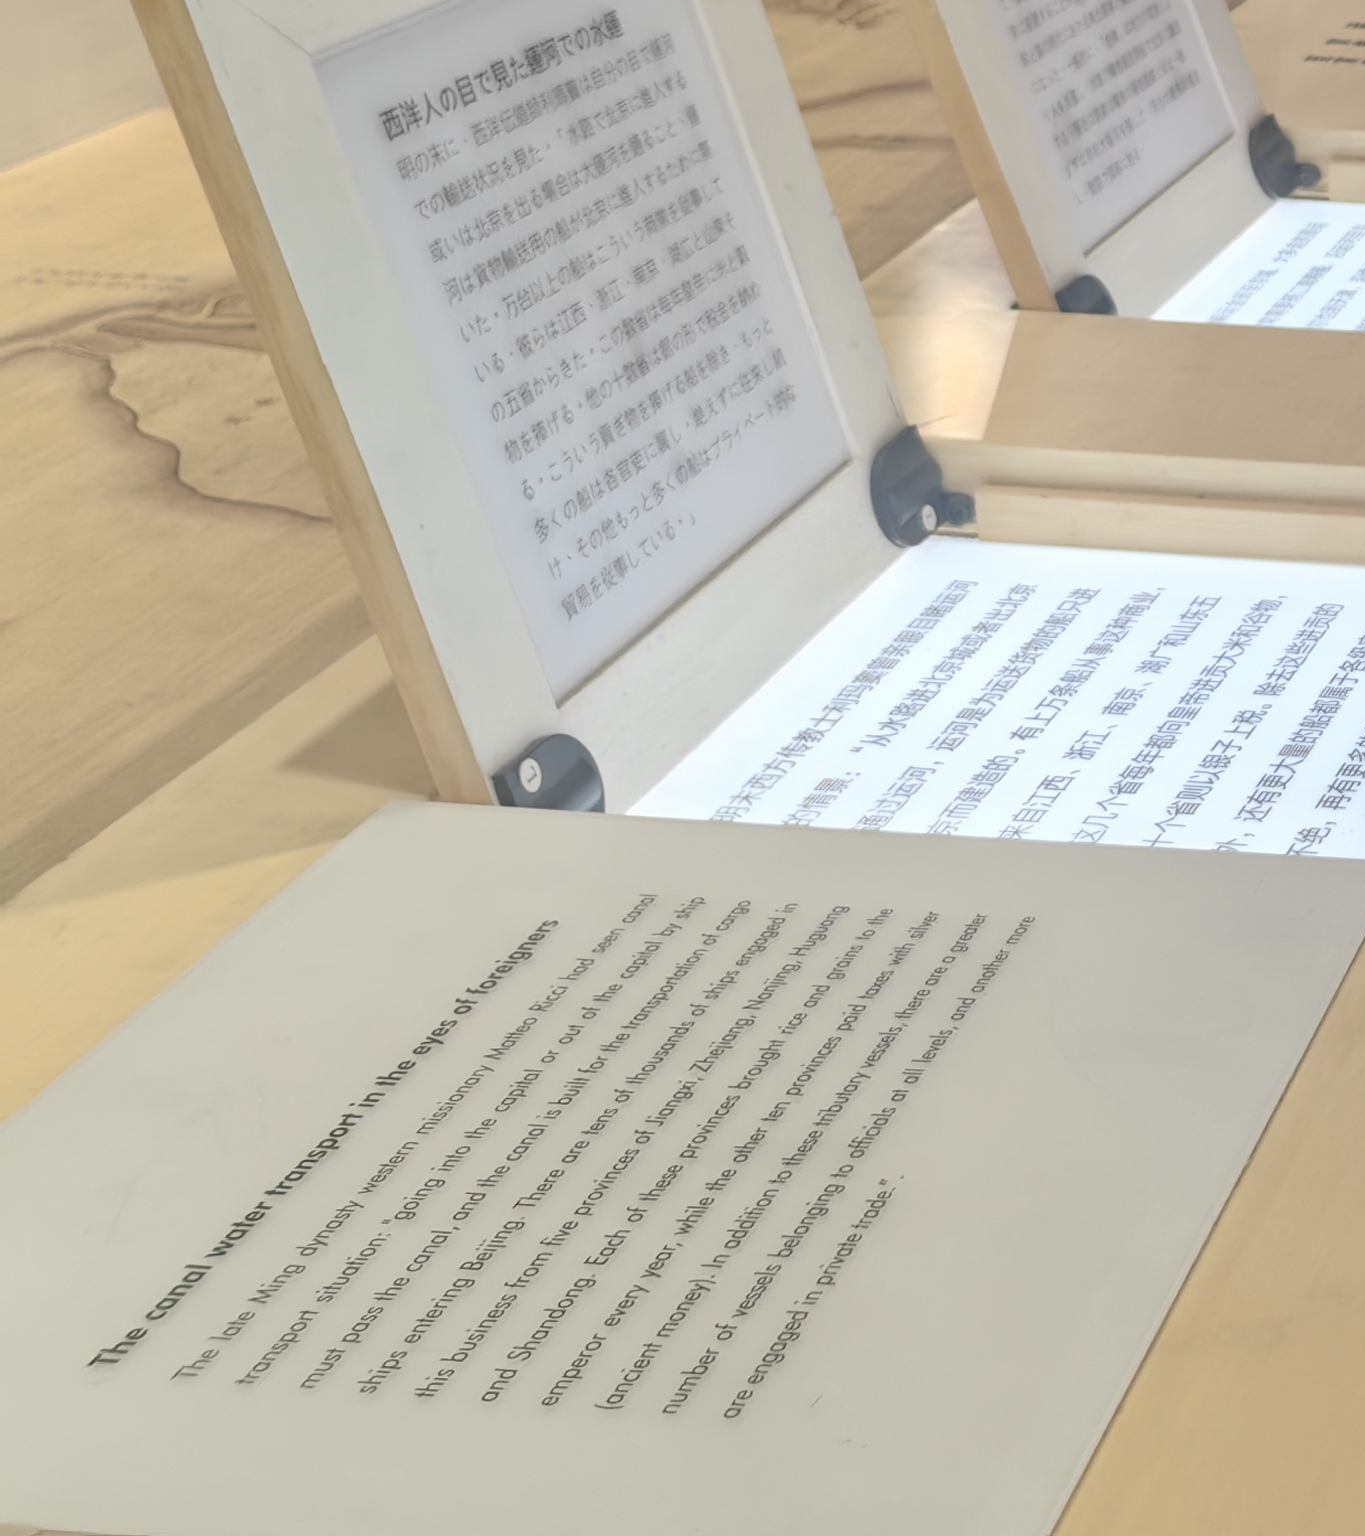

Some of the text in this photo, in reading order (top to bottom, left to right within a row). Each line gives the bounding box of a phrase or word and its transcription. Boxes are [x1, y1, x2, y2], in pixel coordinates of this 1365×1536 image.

[716, 899, 753, 932] cargo
[701, 932, 722, 946] of
[620, 948, 710, 1030] transportation
[600, 1032, 632, 1053] the
[577, 1054, 610, 1074] for
[547, 1076, 592, 1106] built
[700, 1253, 733, 1269] In
[724, 1188, 781, 1250] addition
[768, 1169, 794, 1185] to
[781, 1129, 825, 1166] these
[812, 1070, 873, 1127] tributary
[894, 988, 933, 1021] there
[925, 965, 950, 987] are
[942, 955, 958, 964] a
[950, 913, 989, 954] greater
[536, 1108, 564, 1120] is
[87, 919, 560, 1367] The canal water transport in the eyes of foreigners
[170, 893, 659, 1381] The late Ming dynasty western missionary Matteo Ricci had seen canal
[235, 1309, 321, 1385] transport
[430, 1145, 472, 1172] into
[464, 1117, 499, 1139] the
[494, 1068, 545, 1113] capital
[540, 1048, 561, 1064] or
[558, 1024, 587, 1045] out
[581, 1006, 602, 1020] of
[593, 983, 625, 1003] the
[620, 940, 665, 980] capital
[652, 922, 684, 937] by
[674, 896, 708, 920] ship
[357, 1350, 410, 1395] ships
[404, 1277, 477, 1344] entering
[512, 1168, 567, 1210] There
[561, 1140, 592, 1164] are
[581, 1107, 620, 1135] tens
[614, 1087, 636, 1104] of
[625, 1020, 697, 1085] thousands
[690, 1003, 711, 1017] of
[702, 969, 742, 1001] ships
[735, 916, 788, 967] engaged
[775, 902, 800, 914] in
[414, 1368, 457, 1398] this
[439, 1293, 519, 1363] business
[504, 1251, 555, 1289] from
[540, 1219, 581, 1247] five
[574, 1148, 642, 1217] provinces
[634, 1128, 657, 1145] of
[788, 905, 852, 957] Huguang
[481, 1367, 520, 1403] and
[583, 1229, 633, 1266] Each
[626, 1205, 650, 1223] of
[638, 1164, 685, 1202] these
[679, 1094, 742, 1159] provinces
[728, 1039, 787, 1090] brought
[778, 1012, 809, 1035] rice
[803, 984, 832, 1009] and
[826, 944, 865, 981] grains
[855, 928, 877, 941] to
[866, 908, 895, 926] the
[506, 1123, 550, 1162] canal
[477, 1164, 512, 1188] the
[541, 1332, 608, 1407] emperor
[604, 1283, 652, 1327] every
[674, 1196, 717, 1236] while
[705, 1168, 739, 1192] the
[733, 1126, 770, 1164] other
[760, 1101, 793, 1122] ten
[785, 1035, 843, 1097] provinces
[836, 1003, 868, 1032] paid
[857, 969, 896, 1000] taxes
[888, 942, 917, 967] with
[908, 910, 941, 940] silver
[662, 1346, 721, 1415] number
[715, 1322, 740, 1341] of
[731, 1263, 783, 1319] vessels
[767, 1183, 847, 1258] belonging
[829, 1163, 856, 1179] to
[847, 1106, 898, 1159] officials
[891, 1088, 911, 1103] at
[901, 1067, 926, 1085] all
[950, 996, 978, 1022] and
[971, 948, 1012, 994] another
[1005, 916, 1037, 945] more
[452, 1191, 488, 1221] and
[373, 1276, 412, 1302] the
[341, 1305, 386, 1344] pass
[724, 1389, 755, 1419] are
[747, 1309, 811, 1385] engaged
[794, 1290, 825, 1306] in
[816, 1232, 864, 1286] private
[300, 1347, 348, 1389] must
